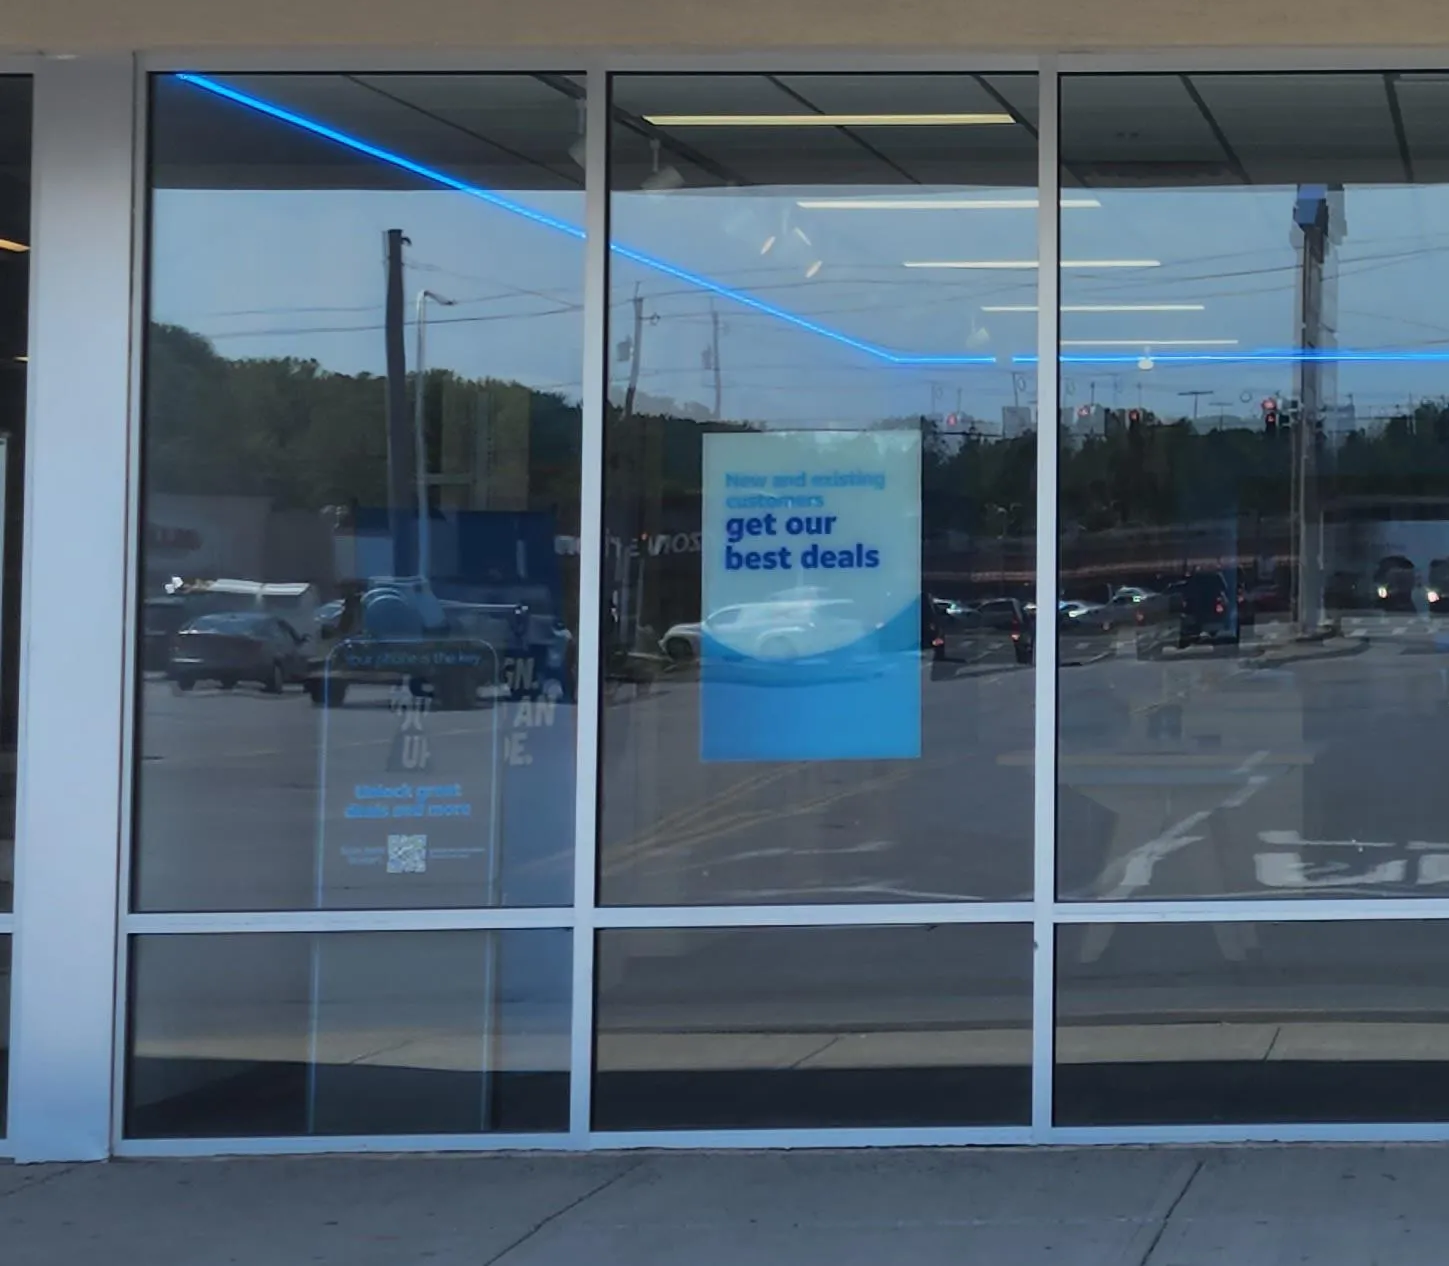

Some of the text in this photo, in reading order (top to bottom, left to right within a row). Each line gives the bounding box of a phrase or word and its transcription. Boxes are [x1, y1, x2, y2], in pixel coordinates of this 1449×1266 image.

[725, 469, 885, 491] New and existing
[725, 494, 824, 509] customers
[726, 513, 837, 543] get our
[725, 543, 880, 570] best deals
